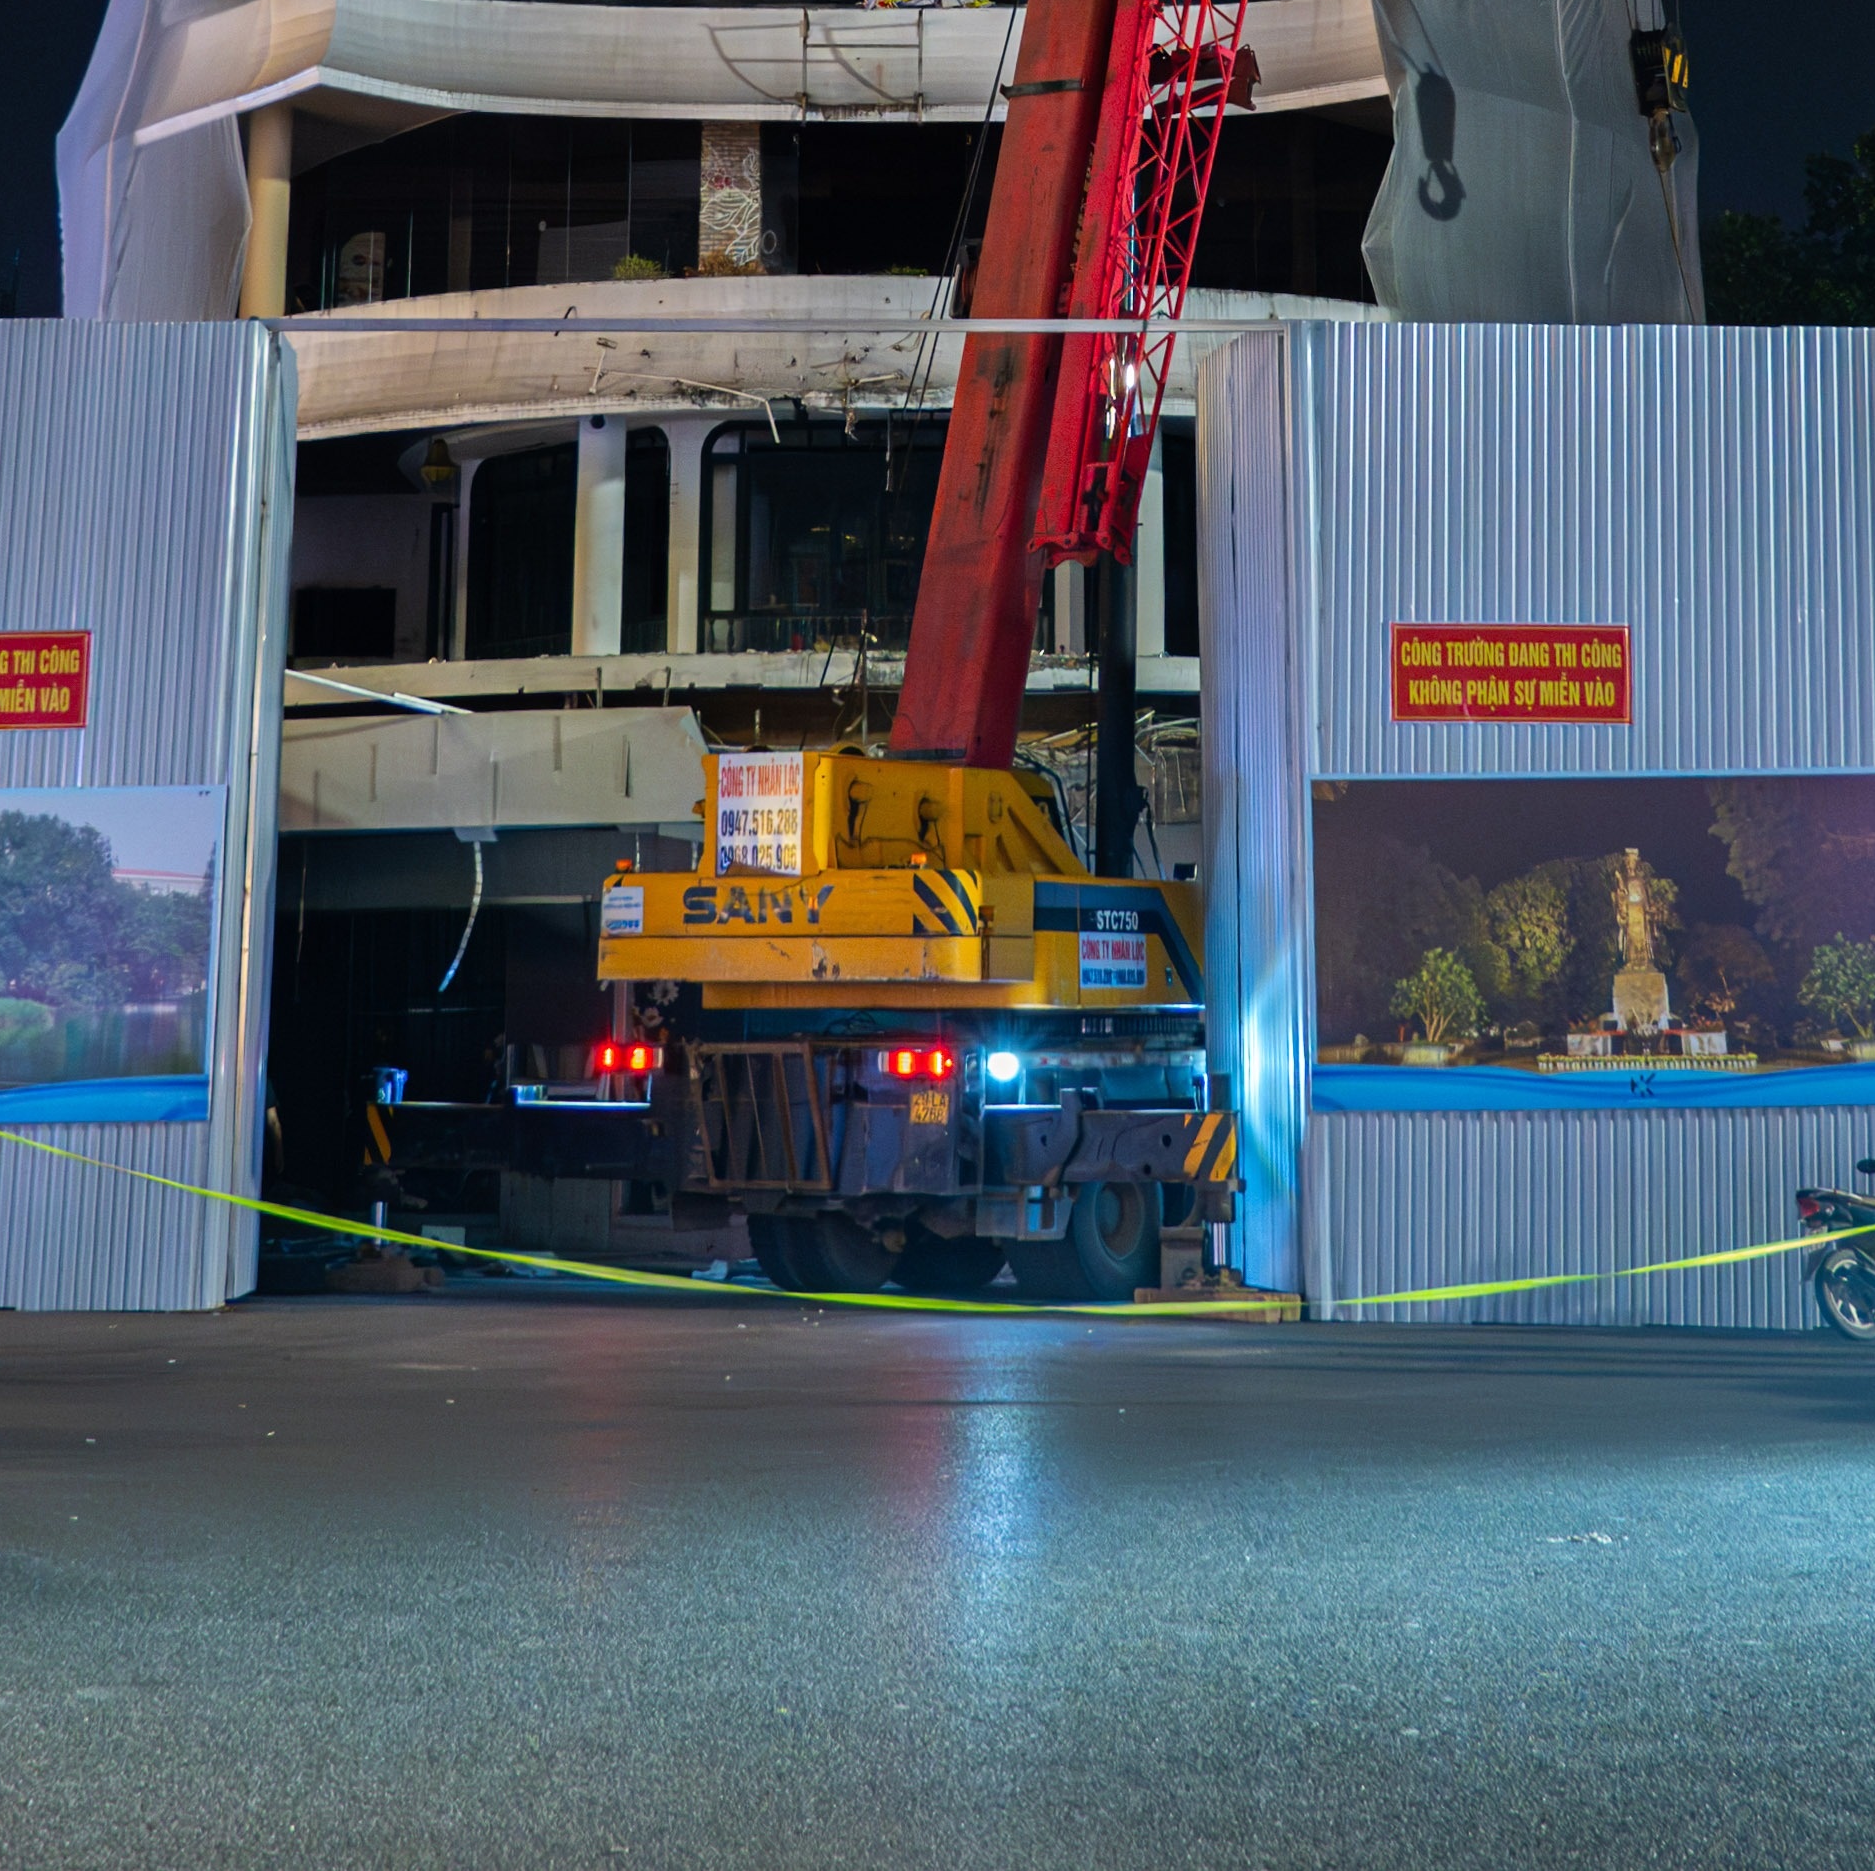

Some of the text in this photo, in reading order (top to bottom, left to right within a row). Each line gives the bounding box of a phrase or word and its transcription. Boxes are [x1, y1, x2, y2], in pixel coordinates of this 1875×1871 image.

[13, 649, 36, 675] THI
[39, 645, 80, 674] CÔNG
[1401, 637, 1442, 667] CÔNG
[1446, 636, 1505, 667] TRƯỜNG
[1554, 643, 1577, 667] THI
[1581, 638, 1622, 668] CÔNG
[40, 683, 70, 713] VÀO
[1409, 672, 1616, 712] KHÔNG PHẬN SỰ MIỄN VÀO
[721, 759, 743, 798] CÔNG
[746, 765, 756, 797] TY
[721, 808, 798, 836] 0947.516.288
[720, 844, 797, 871] 0968025.906
[683, 885, 835, 924] SANY
[1096, 910, 1139, 930] STC750
